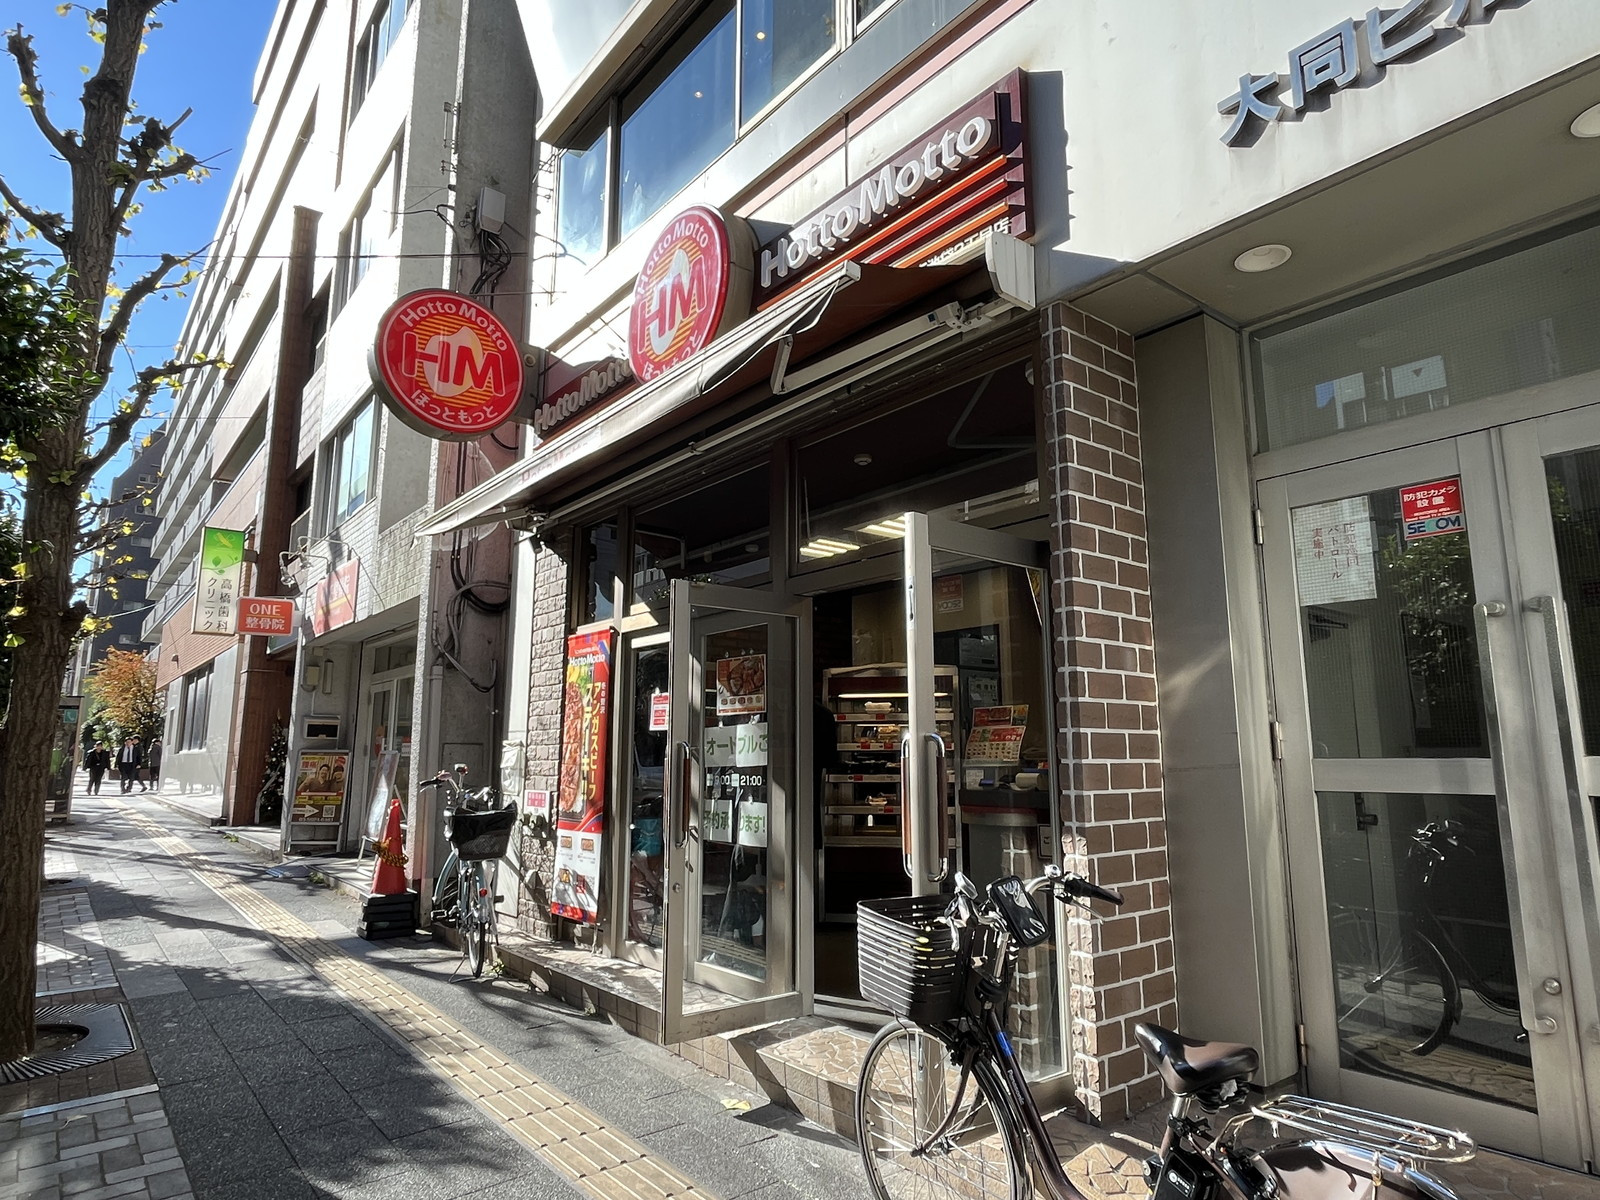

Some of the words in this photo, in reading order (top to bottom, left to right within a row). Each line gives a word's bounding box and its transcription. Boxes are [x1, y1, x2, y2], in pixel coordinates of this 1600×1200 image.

[672, 218, 709, 249] Motto
[400, 301, 456, 328] Hotto
[458, 303, 508, 351] Motto
[402, 331, 506, 397] HM
[411, 389, 498, 425] ほっともっと
[1403, 485, 1457, 502] 防犯カメラ
[1416, 496, 1446, 508] 設置
[1407, 516, 1461, 535] SECOM
[1328, 526, 1344, 580] パトロール
[202, 577, 217, 631] クリニック
[216, 578, 233, 632] 高橋歯科
[249, 603, 281, 616] ONE
[245, 616, 285, 631] 整骨院
[588, 681, 601, 801] アンガスビーフ
[740, 775, 762, 786] 21:00
